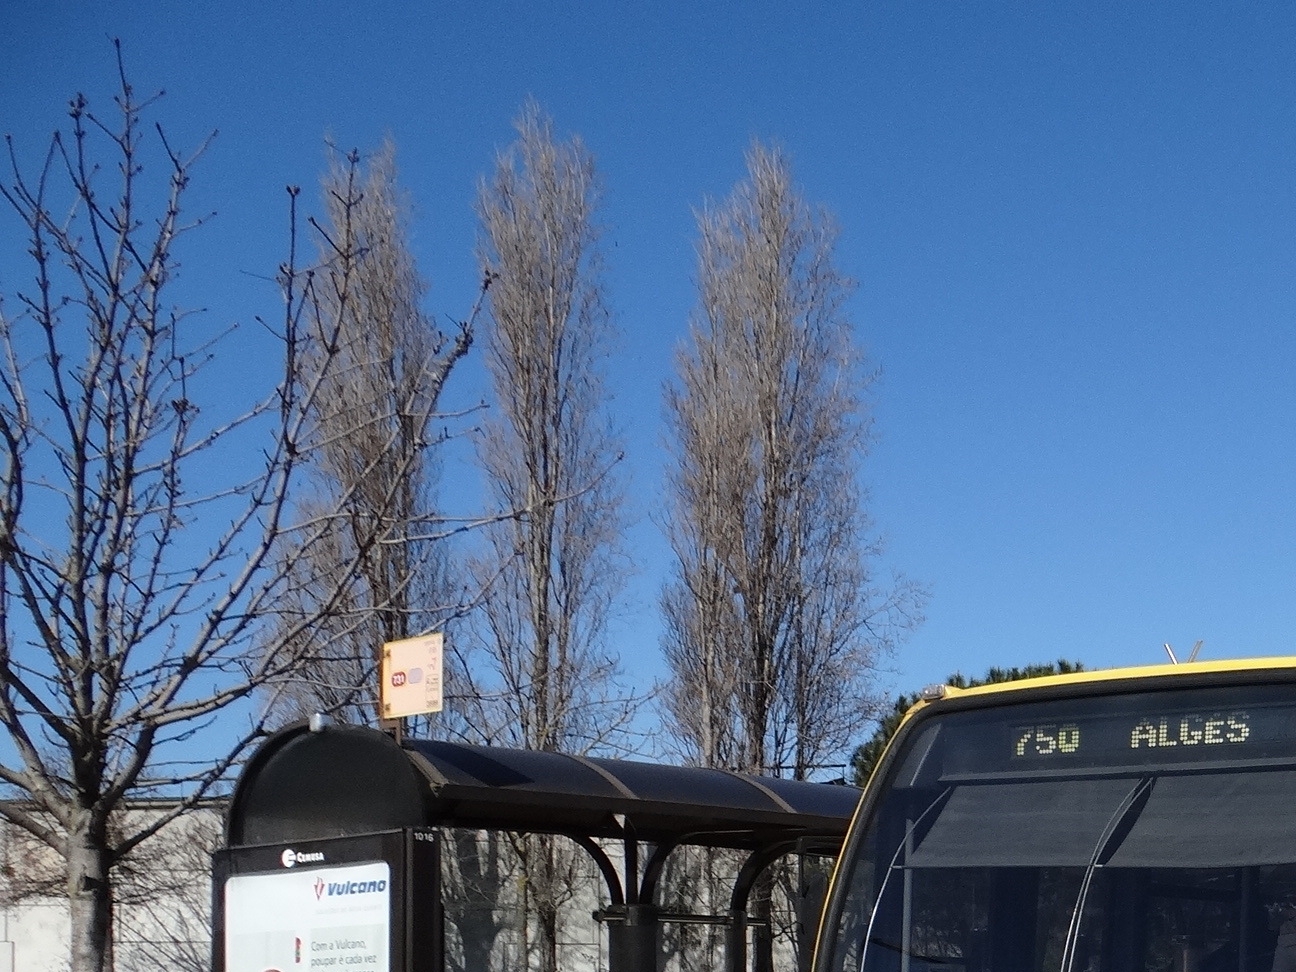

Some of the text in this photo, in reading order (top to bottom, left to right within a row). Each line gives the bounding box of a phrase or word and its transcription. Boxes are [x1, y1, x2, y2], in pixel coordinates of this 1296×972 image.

[1015, 711, 1250, 756] 750 ALGES
[414, 832, 434, 842] 1016
[327, 879, 387, 896] Vulcano
[311, 941, 327, 951] Com
[311, 957, 337, 968] poupar
[345, 953, 362, 965] cada
[364, 954, 377, 964] vez
